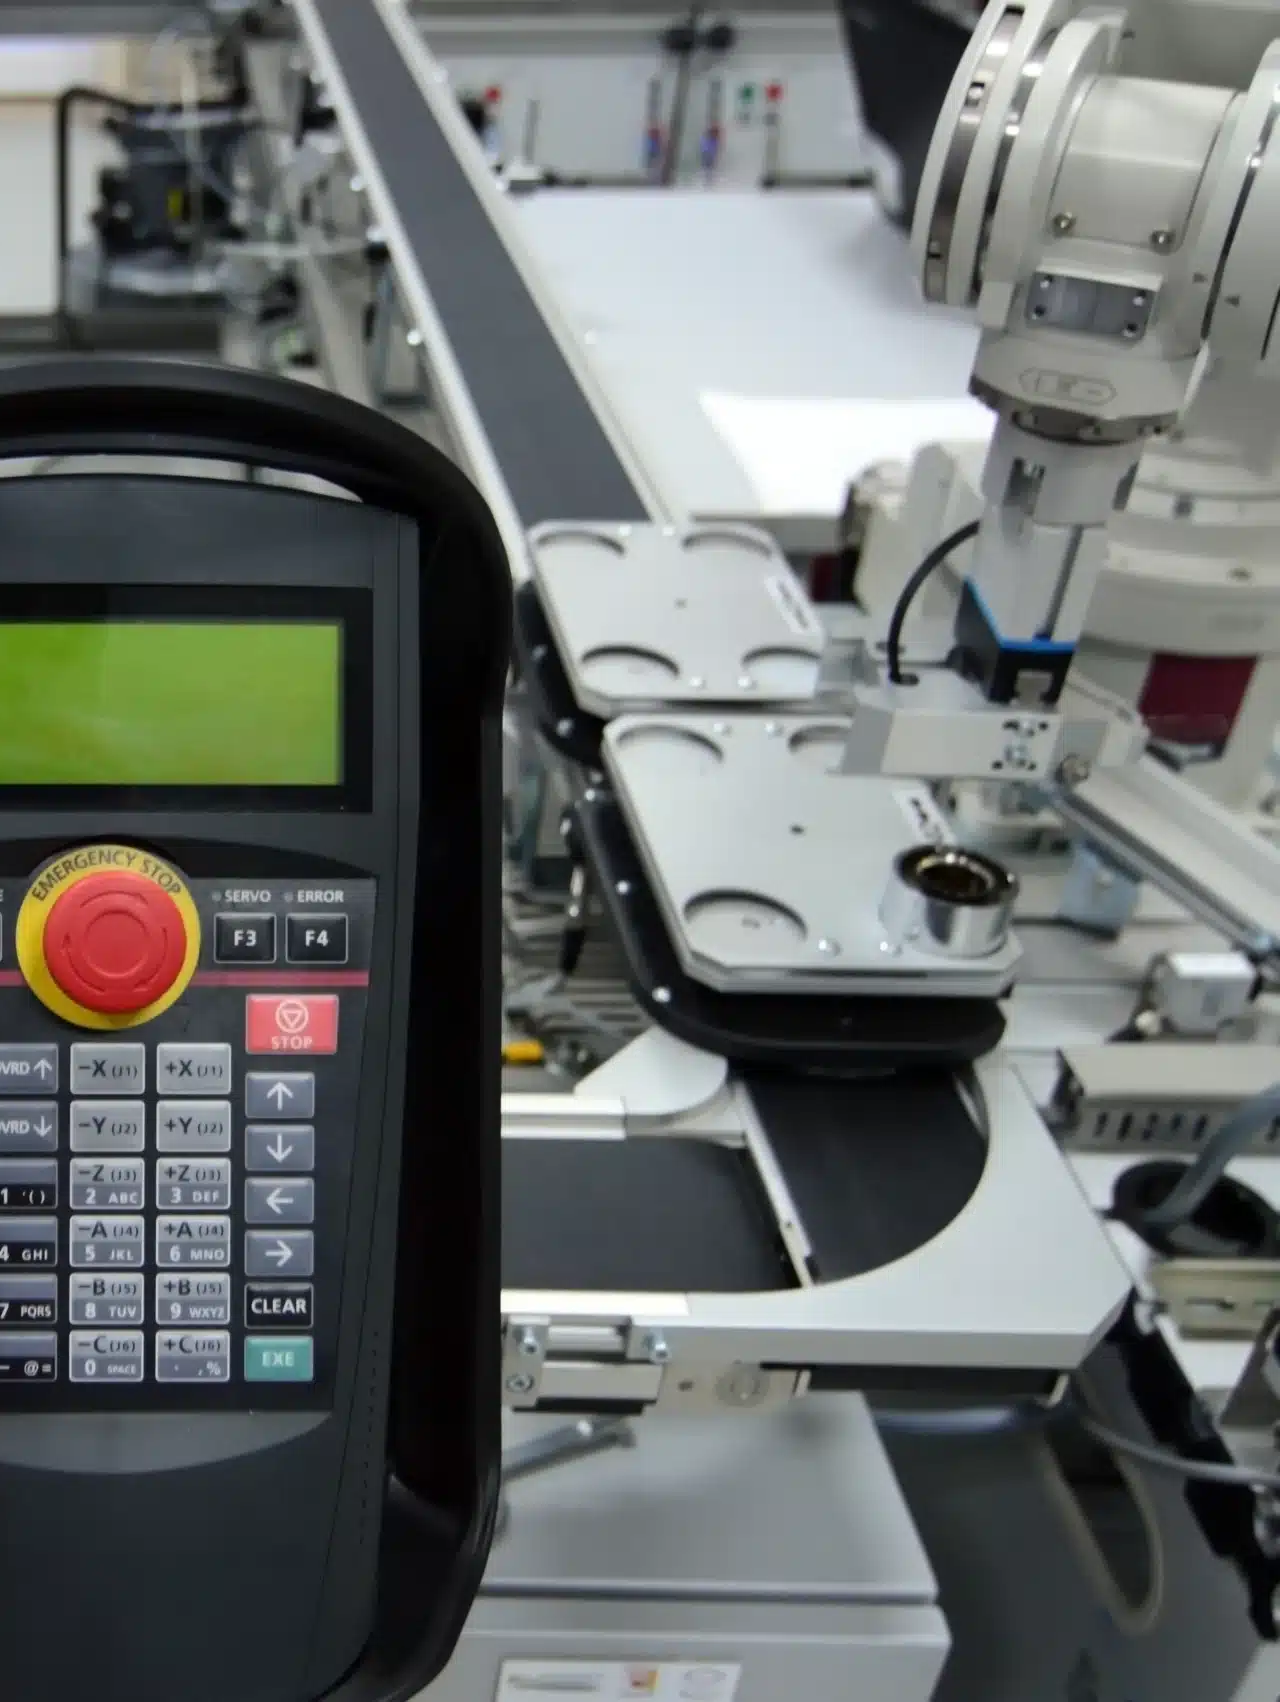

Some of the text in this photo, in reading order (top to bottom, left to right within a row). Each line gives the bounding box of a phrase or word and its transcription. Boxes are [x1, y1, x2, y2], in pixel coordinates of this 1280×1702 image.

[32, 850, 181, 901] EMERGENCY STOP
[224, 889, 272, 903] SERVO
[297, 889, 344, 903] ERROR
[233, 929, 257, 947] F3
[305, 929, 329, 947] F4
[271, 1035, 313, 1050] STOP
[78, 1059, 138, 1079] -X (J1)
[165, 1059, 223, 1079] +X (J1)
[78, 1116, 137, 1137] -Y (J2)
[164, 1116, 223, 1137] +Y (J2)
[78, 1164, 137, 1182] -Z (J3)
[164, 1164, 190, 1182] +Z
[0, 1187, 9, 1205] 1
[85, 1187, 139, 1205] 2 ABC
[170, 1186, 220, 1204] 3 DEF
[78, 1220, 139, 1239] -A (J4)
[164, 1221, 225, 1239] +A (J4)
[21, 1248, 48, 1261] GHI
[85, 1244, 134, 1262] 5 JKL
[170, 1244, 225, 1262] 6 MNO
[78, 1279, 137, 1296] -B (J5)
[164, 1279, 222, 1296] +B (J5)
[0, 1302, 52, 1320] 7 PQRS
[84, 1302, 137, 1319] 8 TUV
[170, 1302, 225, 1319] 9 WXYZ
[251, 1298, 307, 1315] CLEAR
[78, 1335, 136, 1354] -C (J6)
[164, 1335, 193, 1354] +C
[84, 1358, 137, 1376] 0 SPACE
[261, 1351, 295, 1367] EXE
